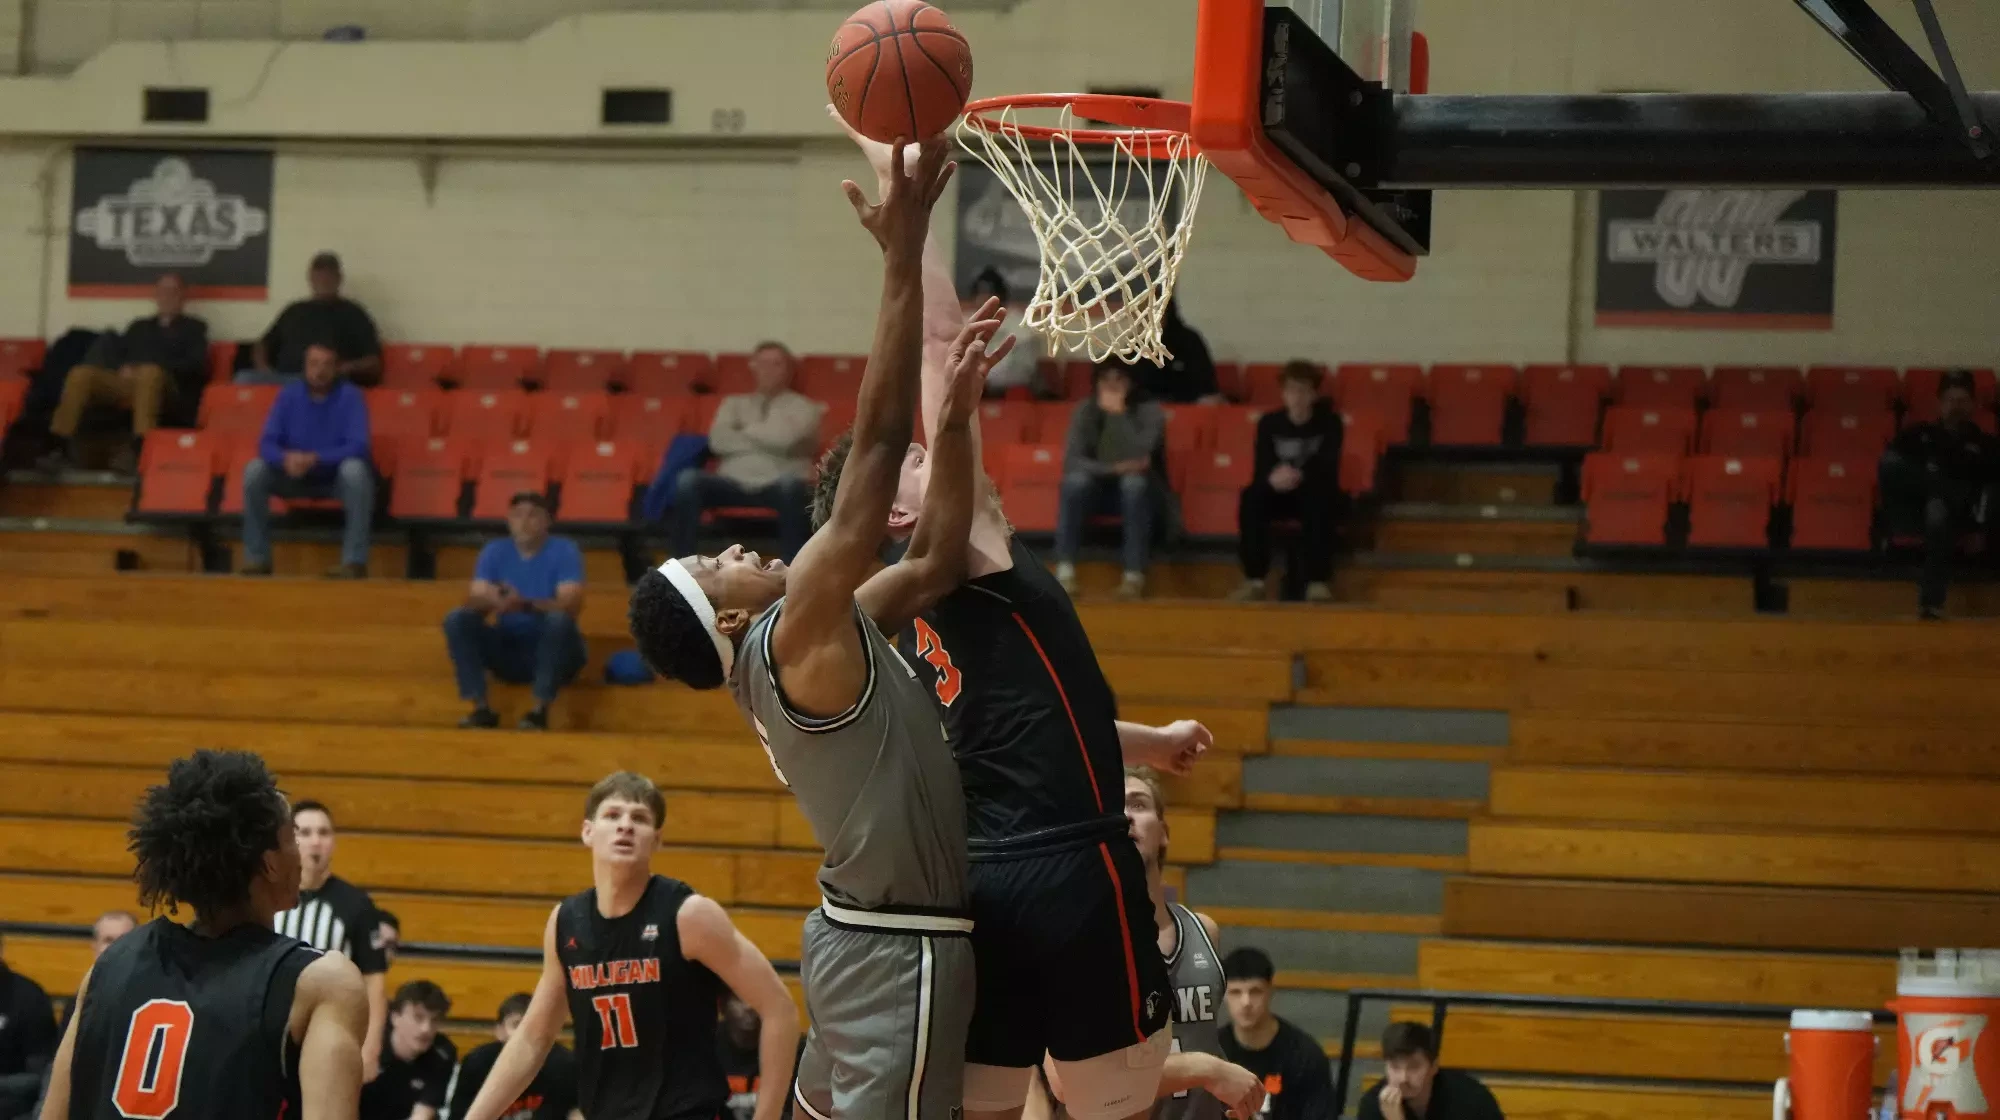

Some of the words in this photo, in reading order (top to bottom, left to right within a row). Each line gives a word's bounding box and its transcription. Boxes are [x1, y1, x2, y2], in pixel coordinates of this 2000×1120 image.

[106, 201, 237, 241] TEXAS
[1632, 232, 1800, 256] WALTERS
[914, 616, 962, 707] 3
[568, 957, 661, 989] MILLIGAN
[592, 993, 638, 1050] 11
[1173, 985, 1215, 1023] KE
[112, 998, 194, 1120] 0
